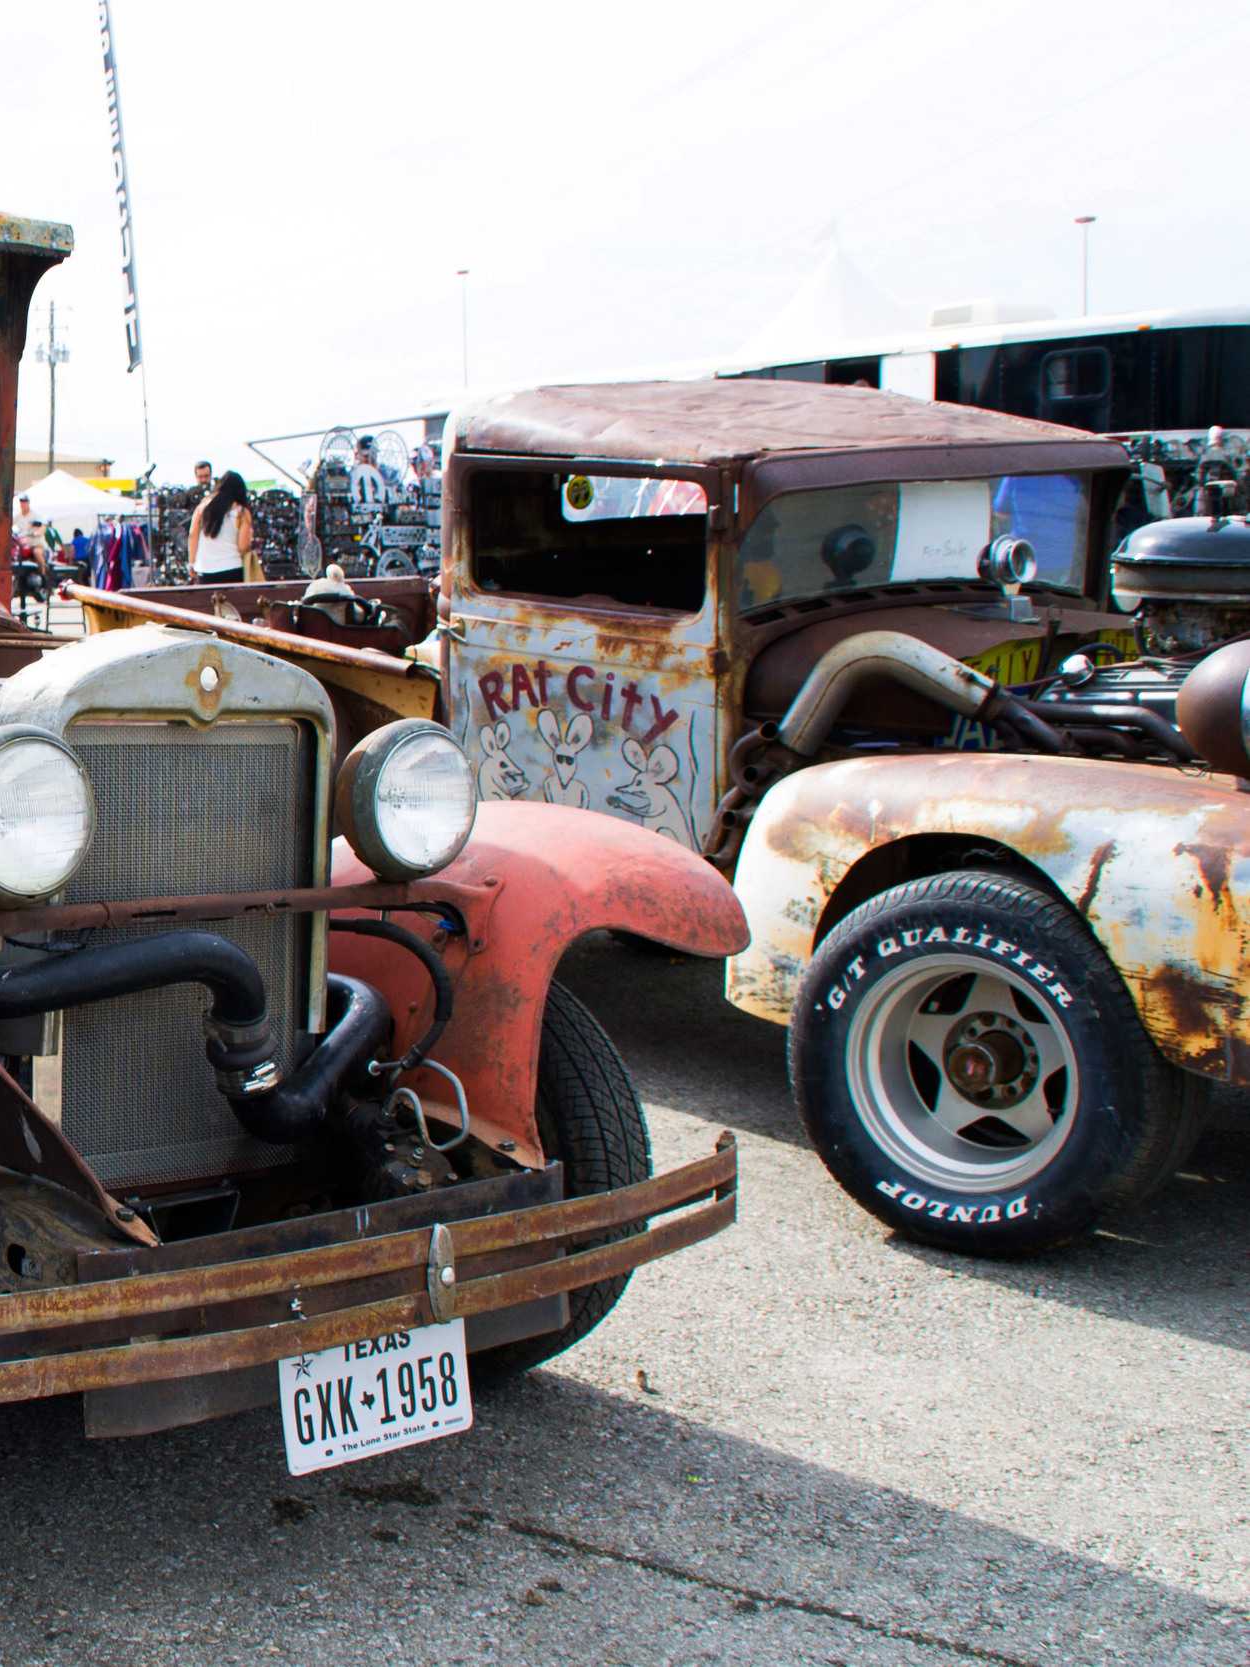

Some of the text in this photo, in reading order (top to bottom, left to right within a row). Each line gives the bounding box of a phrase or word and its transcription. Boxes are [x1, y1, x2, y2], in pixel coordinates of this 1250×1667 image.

[566, 665, 680, 744] City
[827, 925, 1075, 1011] G/T QUALIFIER
[875, 1180, 1031, 1225] DUNLOP
[343, 1331, 411, 1362] TEXAS
[294, 1351, 458, 1446] GXK 1958
[342, 1424, 426, 1453] The Lone Star State
